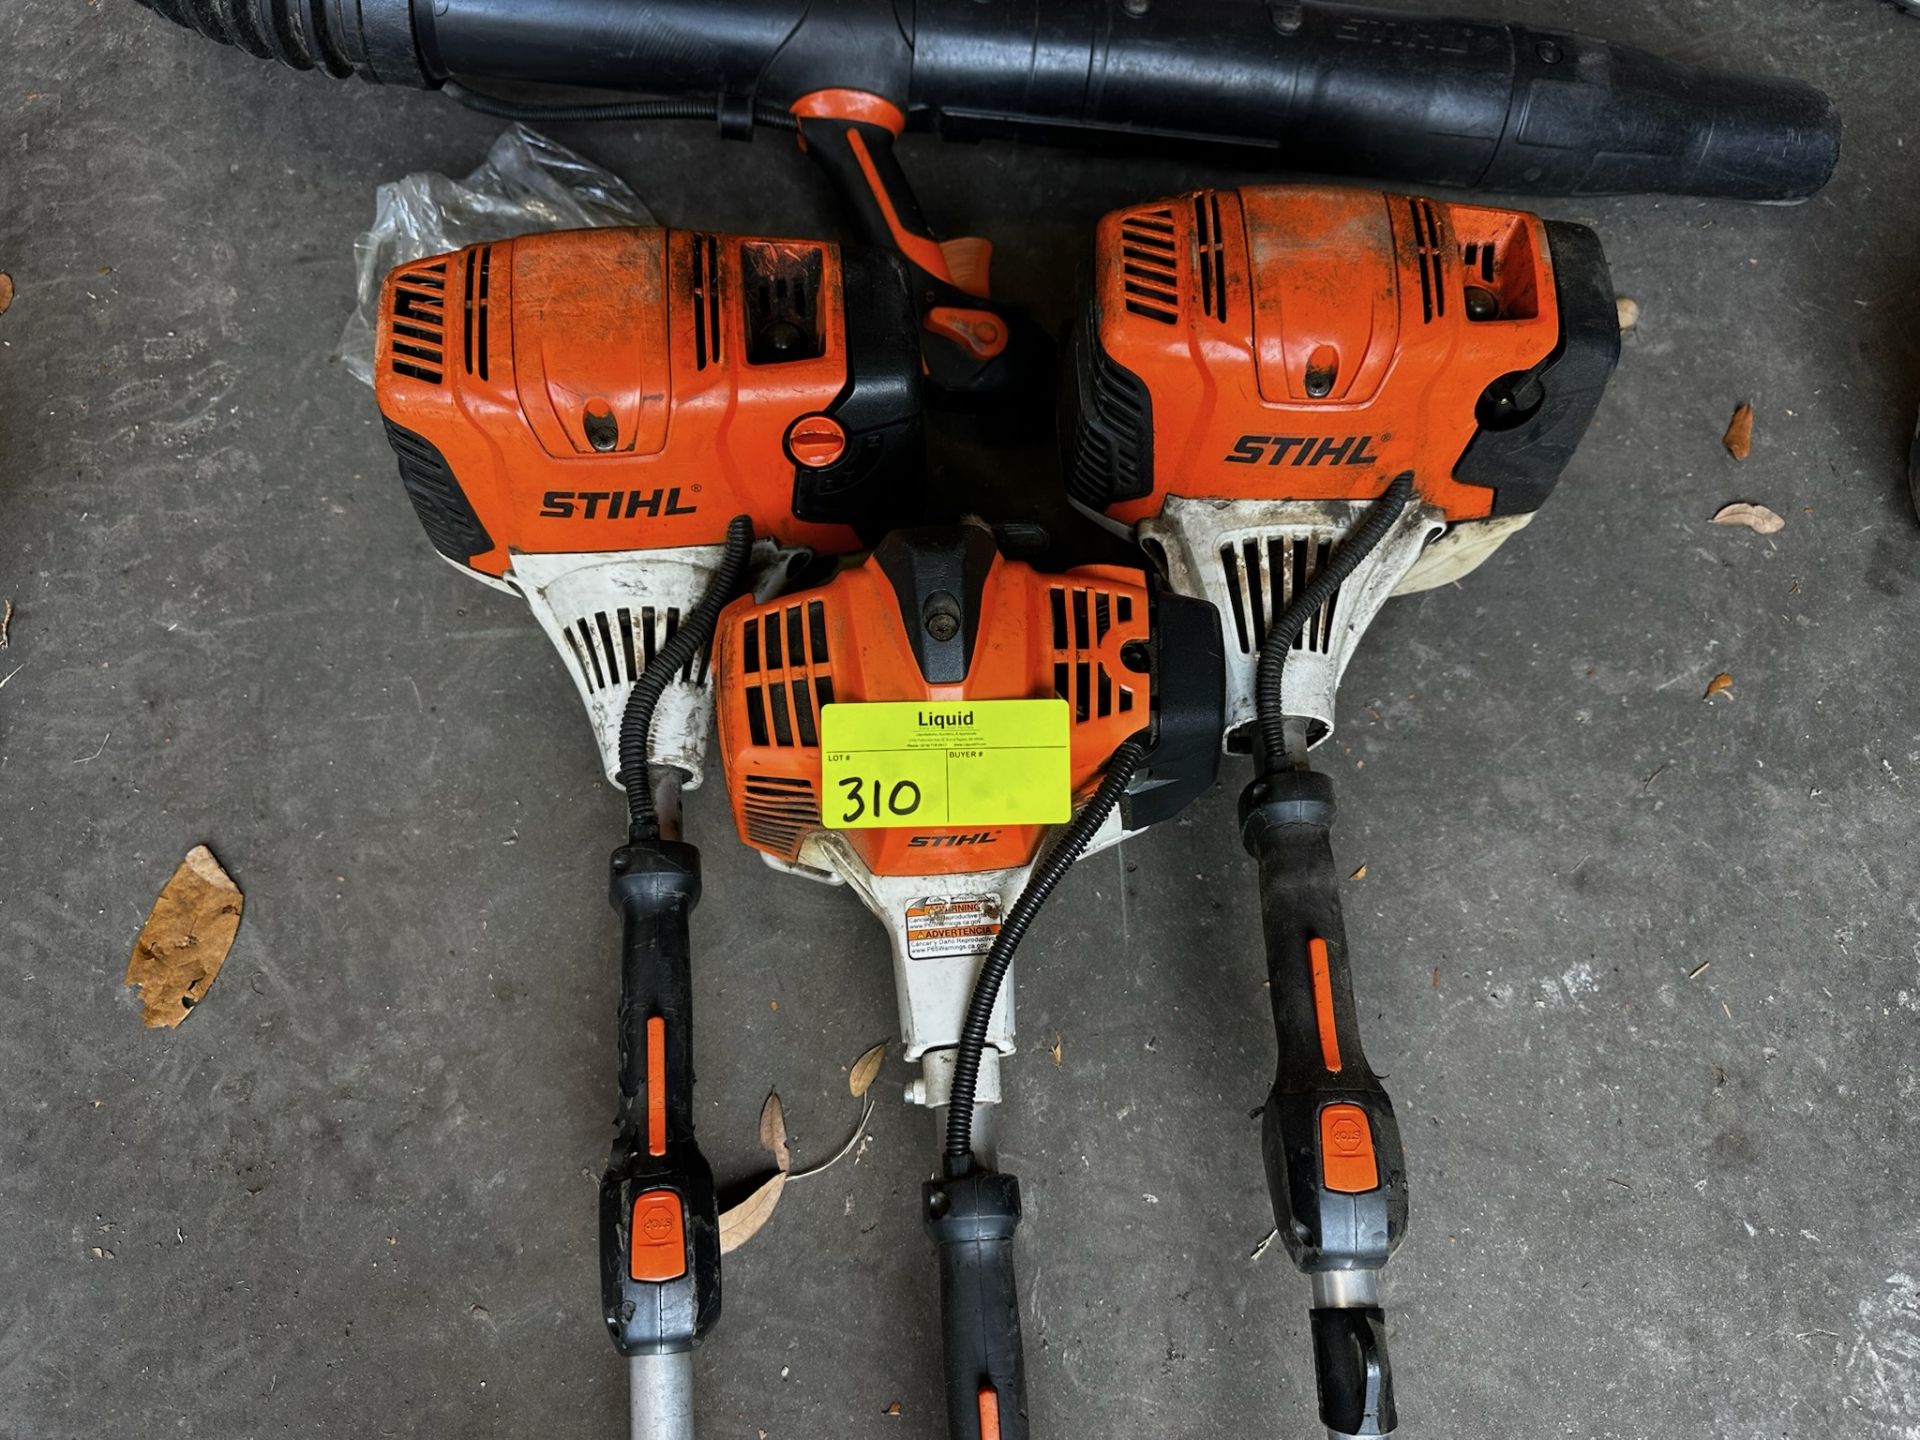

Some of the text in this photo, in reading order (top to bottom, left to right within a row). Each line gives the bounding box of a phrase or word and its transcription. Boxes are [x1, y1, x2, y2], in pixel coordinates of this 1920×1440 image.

[1224, 435, 1378, 466] STIHL
[539, 487, 697, 519] STIHL
[918, 711, 974, 729] Liquid
[838, 776, 921, 823] 310
[907, 832, 997, 848] STIHL
[926, 926, 992, 938] ADVERTENCIA
